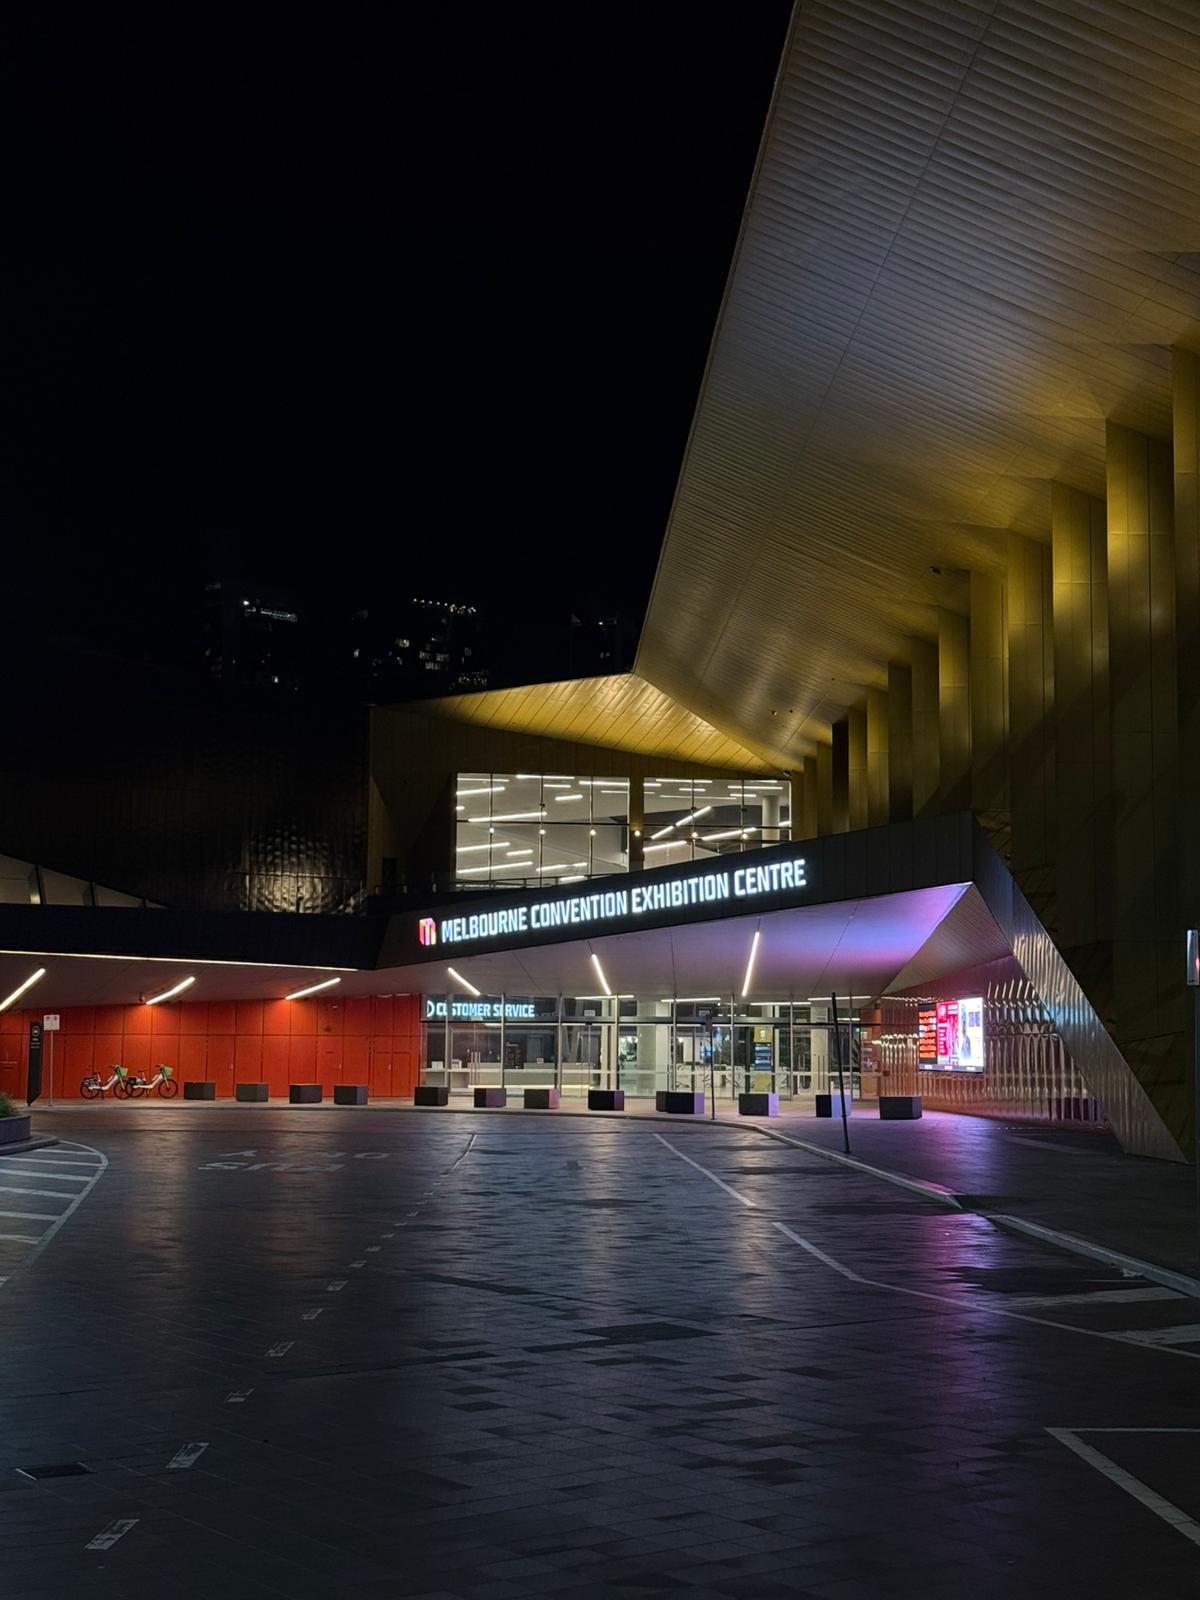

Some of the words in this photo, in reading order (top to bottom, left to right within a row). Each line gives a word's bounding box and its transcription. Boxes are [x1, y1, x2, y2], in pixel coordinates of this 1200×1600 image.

[441, 907, 529, 943] MELBOURNE
[531, 890, 628, 928] CONVENTION
[631, 872, 729, 914] EXHIBITION
[733, 858, 807, 896] CENTRE
